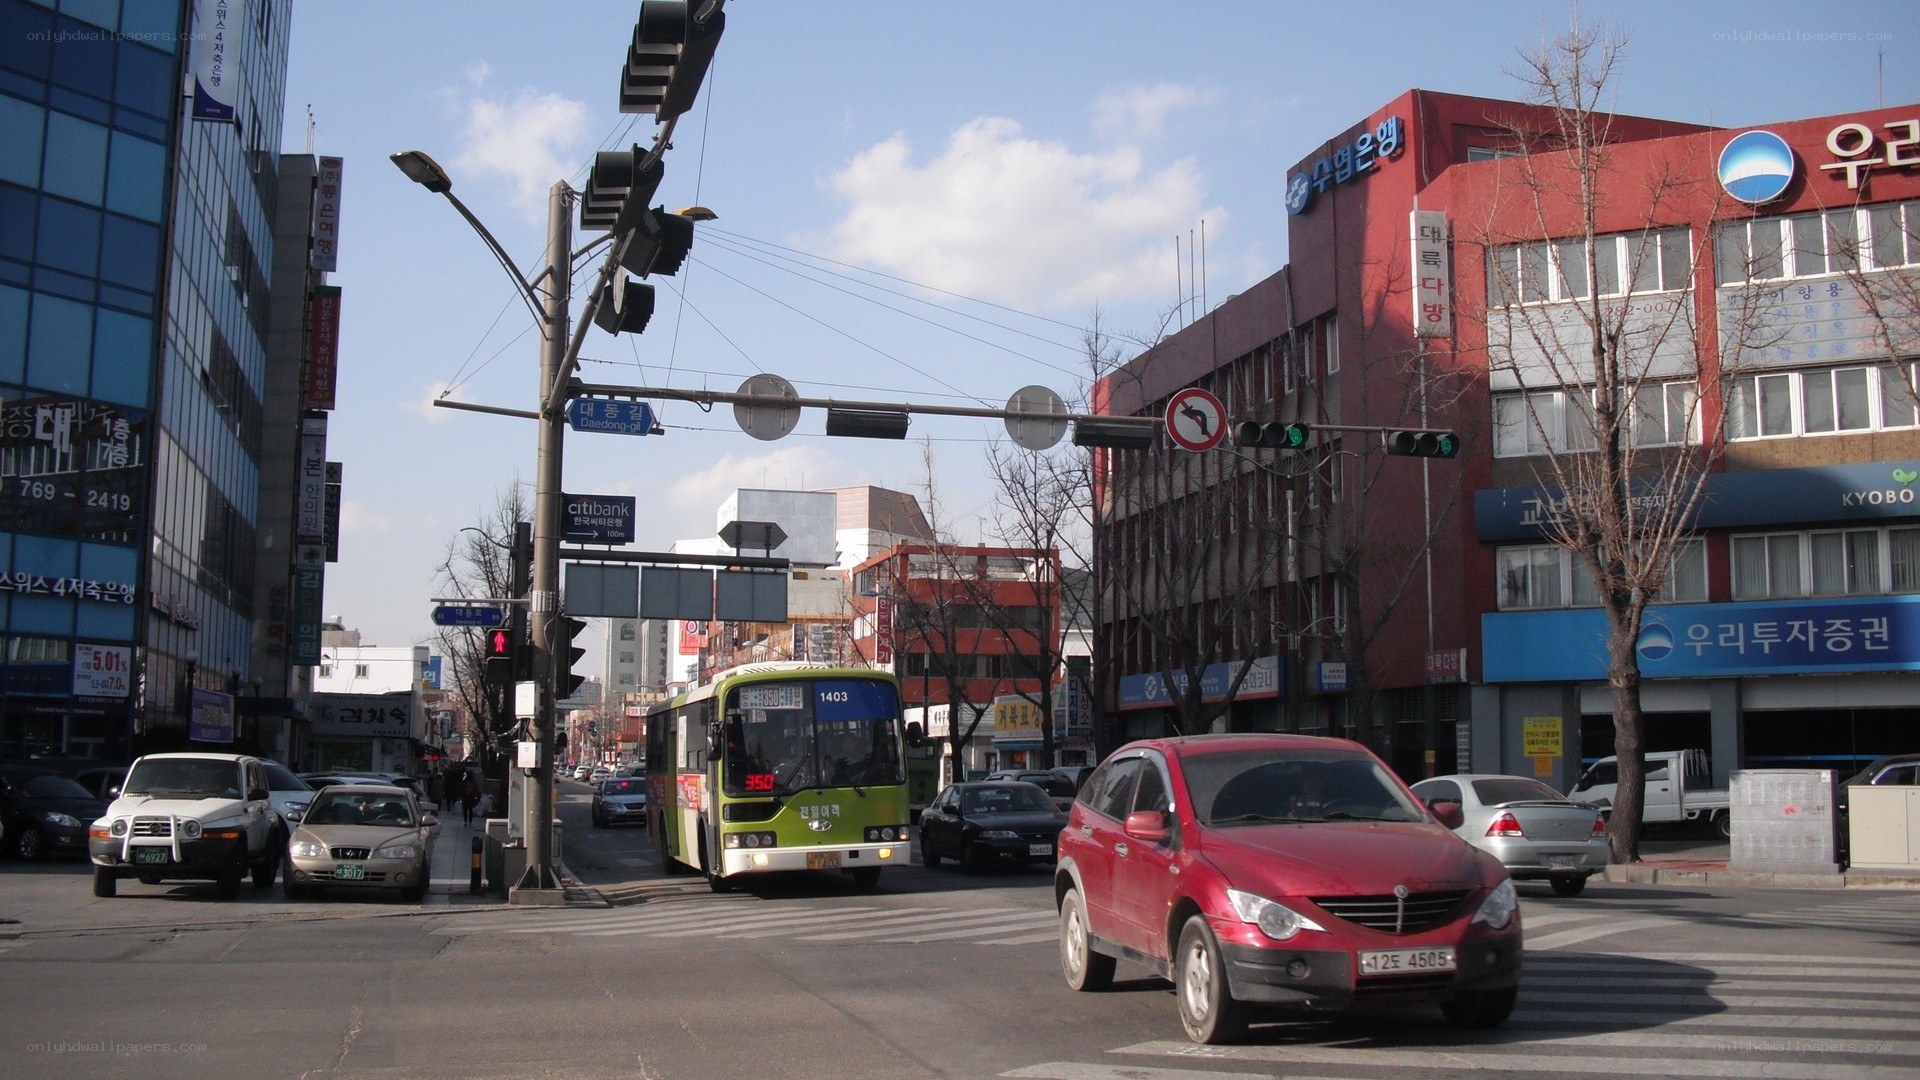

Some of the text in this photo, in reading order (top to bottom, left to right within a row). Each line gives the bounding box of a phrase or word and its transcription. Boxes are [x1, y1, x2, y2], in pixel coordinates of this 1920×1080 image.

[1311, 115, 1401, 194] 수협은행
[1419, 225, 1443, 323] 대륙다방
[1604, 300, 1684, 317] 282-007
[579, 403, 642, 421] 대동길
[580, 418, 641, 432] Daedong-gil
[1842, 488, 1915, 507] KYOBO
[568, 501, 628, 517] citibank
[573, 516, 623, 527] 한국씨티은행
[606, 530, 625, 538] 100m
[1683, 616, 1890, 657] 우리투자증권
[820, 691, 849, 703] 1403
[745, 774, 775, 791] 350
[799, 804, 840, 819] 전일여객
[1407, 952, 1445, 967] 4505
